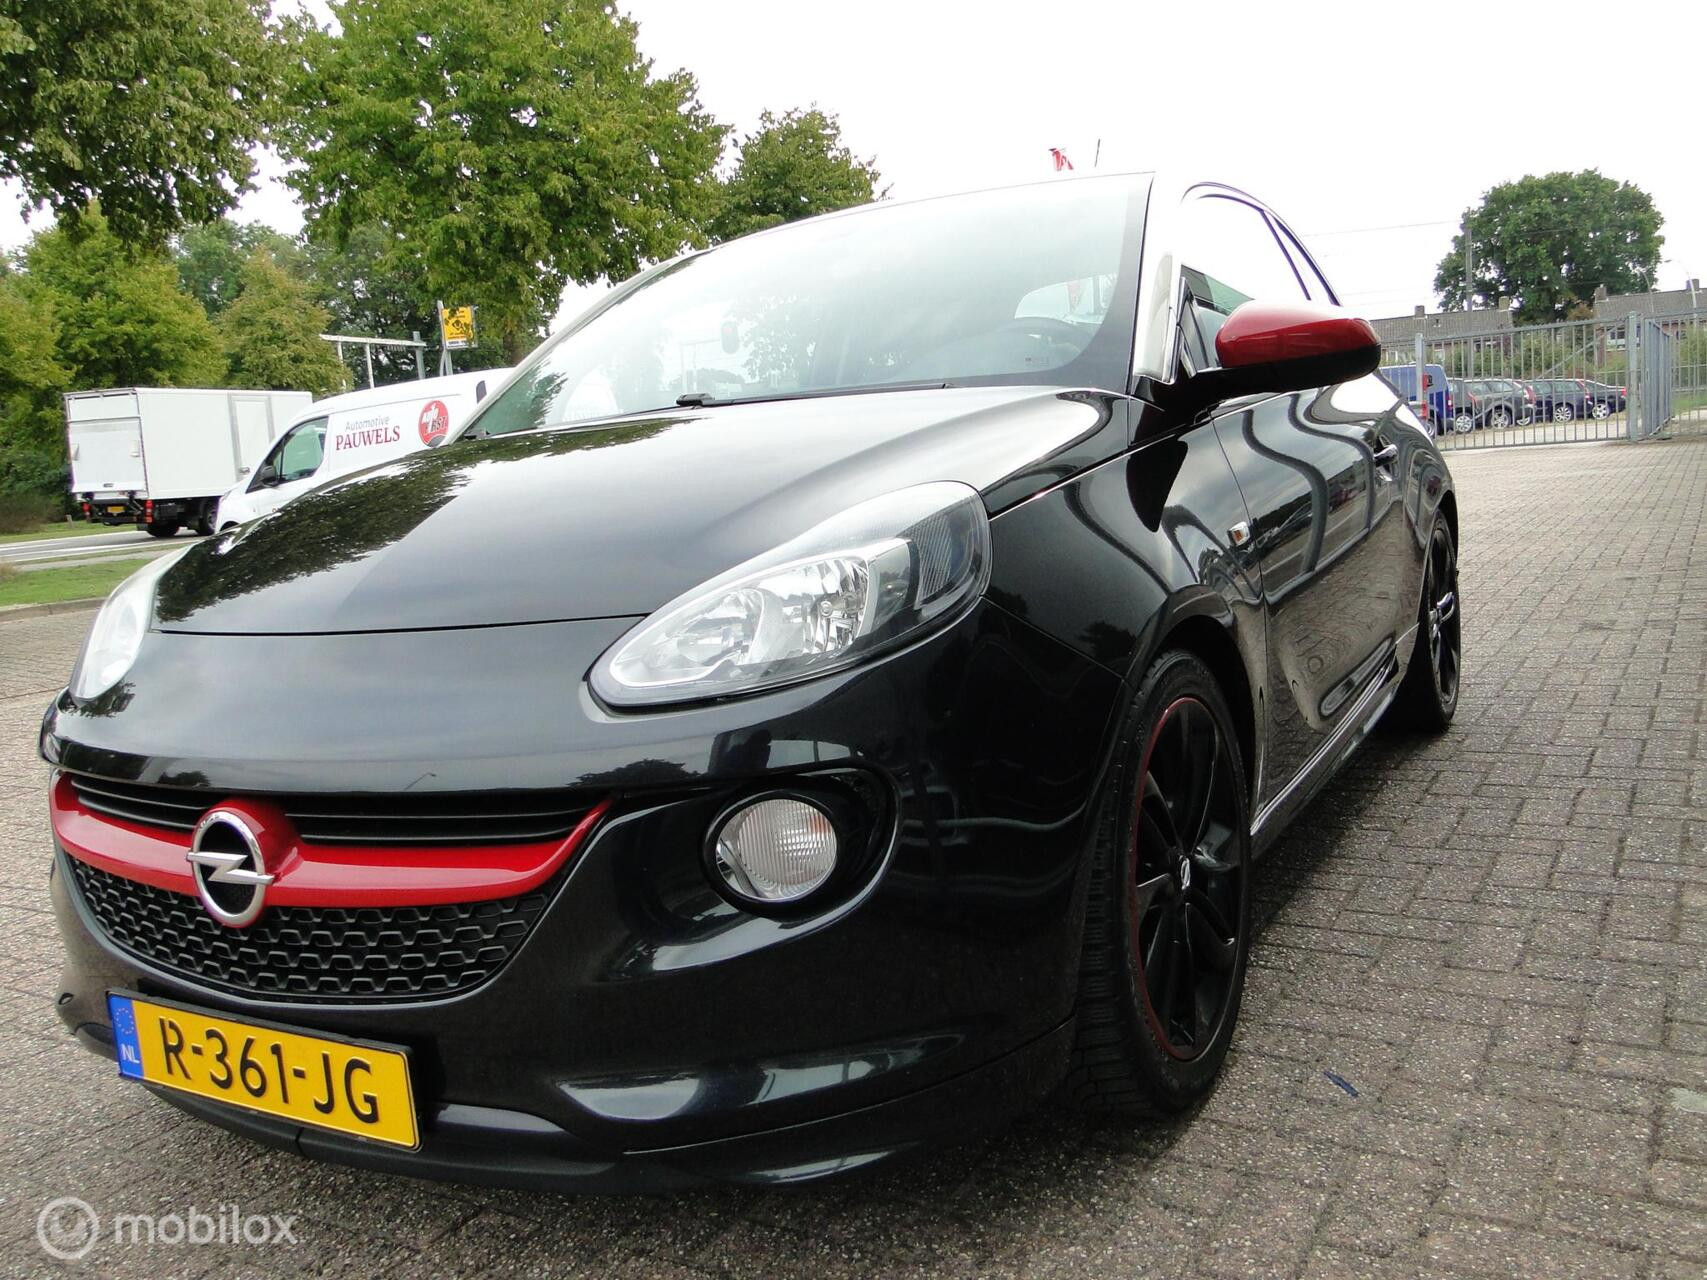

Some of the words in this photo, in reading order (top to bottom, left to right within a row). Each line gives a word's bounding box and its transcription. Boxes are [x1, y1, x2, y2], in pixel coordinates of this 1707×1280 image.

[346, 416, 390, 431] Automotive
[336, 425, 400, 450] PAUWELS
[121, 1044, 141, 1064] NL
[159, 1017, 380, 1123] R-361-JG
